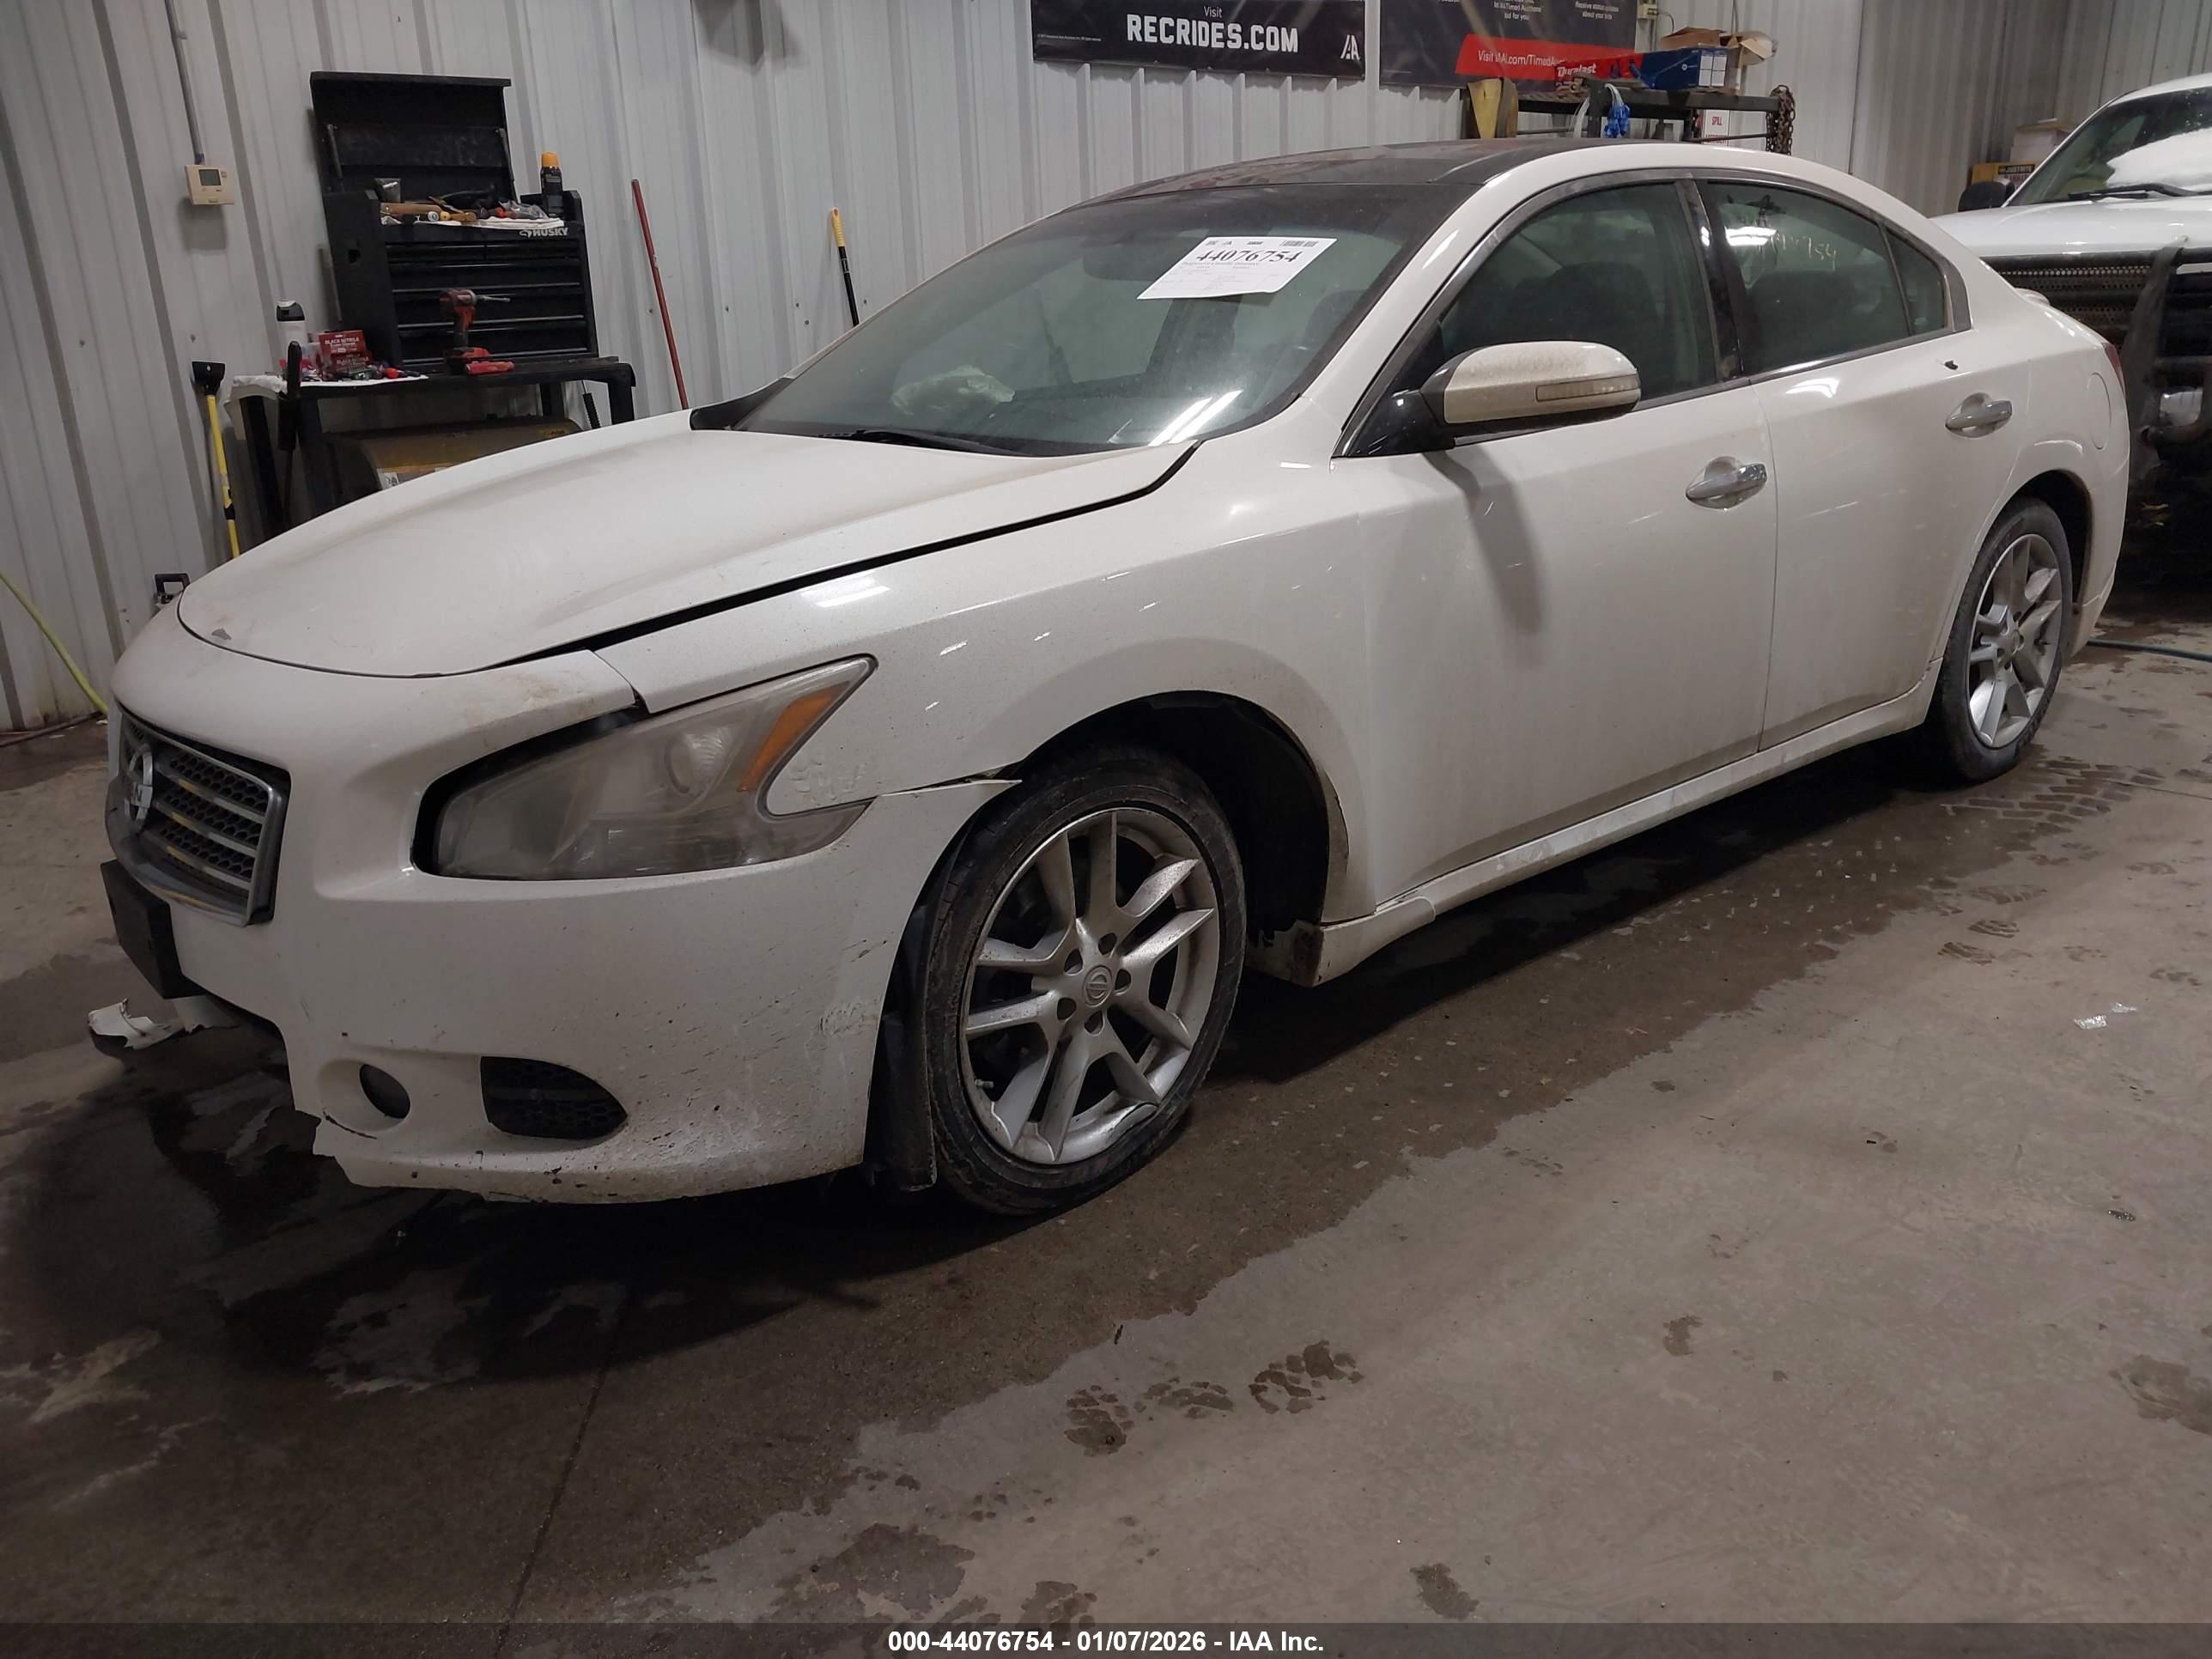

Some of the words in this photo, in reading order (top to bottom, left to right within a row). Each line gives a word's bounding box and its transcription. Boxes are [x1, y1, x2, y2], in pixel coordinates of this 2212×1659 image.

[1203, 6, 1223, 19] Visit
[1127, 14, 1298, 52] RECRIDES.COM
[1478, 50, 1494, 63] Visit
[532, 228, 568, 237] HUSKY
[1196, 249, 1303, 263] 44076754
